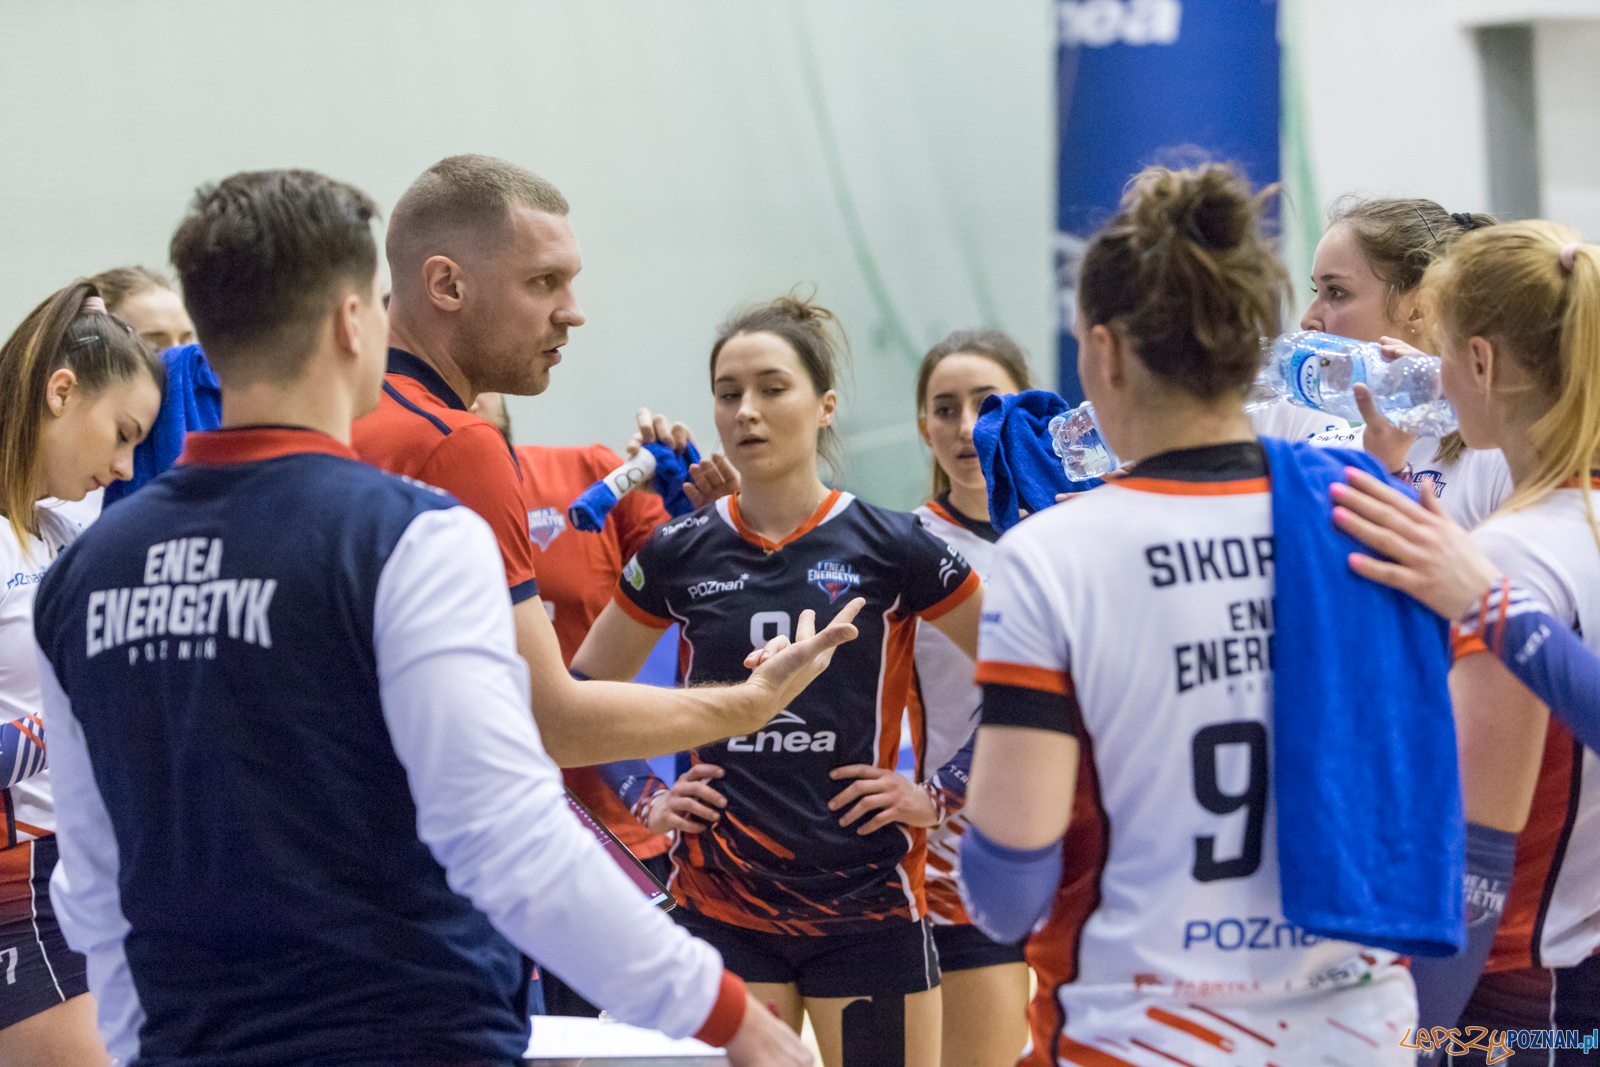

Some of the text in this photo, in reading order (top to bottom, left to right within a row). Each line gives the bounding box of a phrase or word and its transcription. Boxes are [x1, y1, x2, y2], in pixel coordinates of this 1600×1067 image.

[144, 536, 223, 585] ENEA
[807, 569, 861, 585] ENERGETYK
[823, 562, 846, 572] ENEA
[86, 578, 278, 659] ENERGETYK
[1174, 635, 1273, 694] ENER
[727, 730, 837, 752] Enea
[1191, 720, 1268, 882] 9
